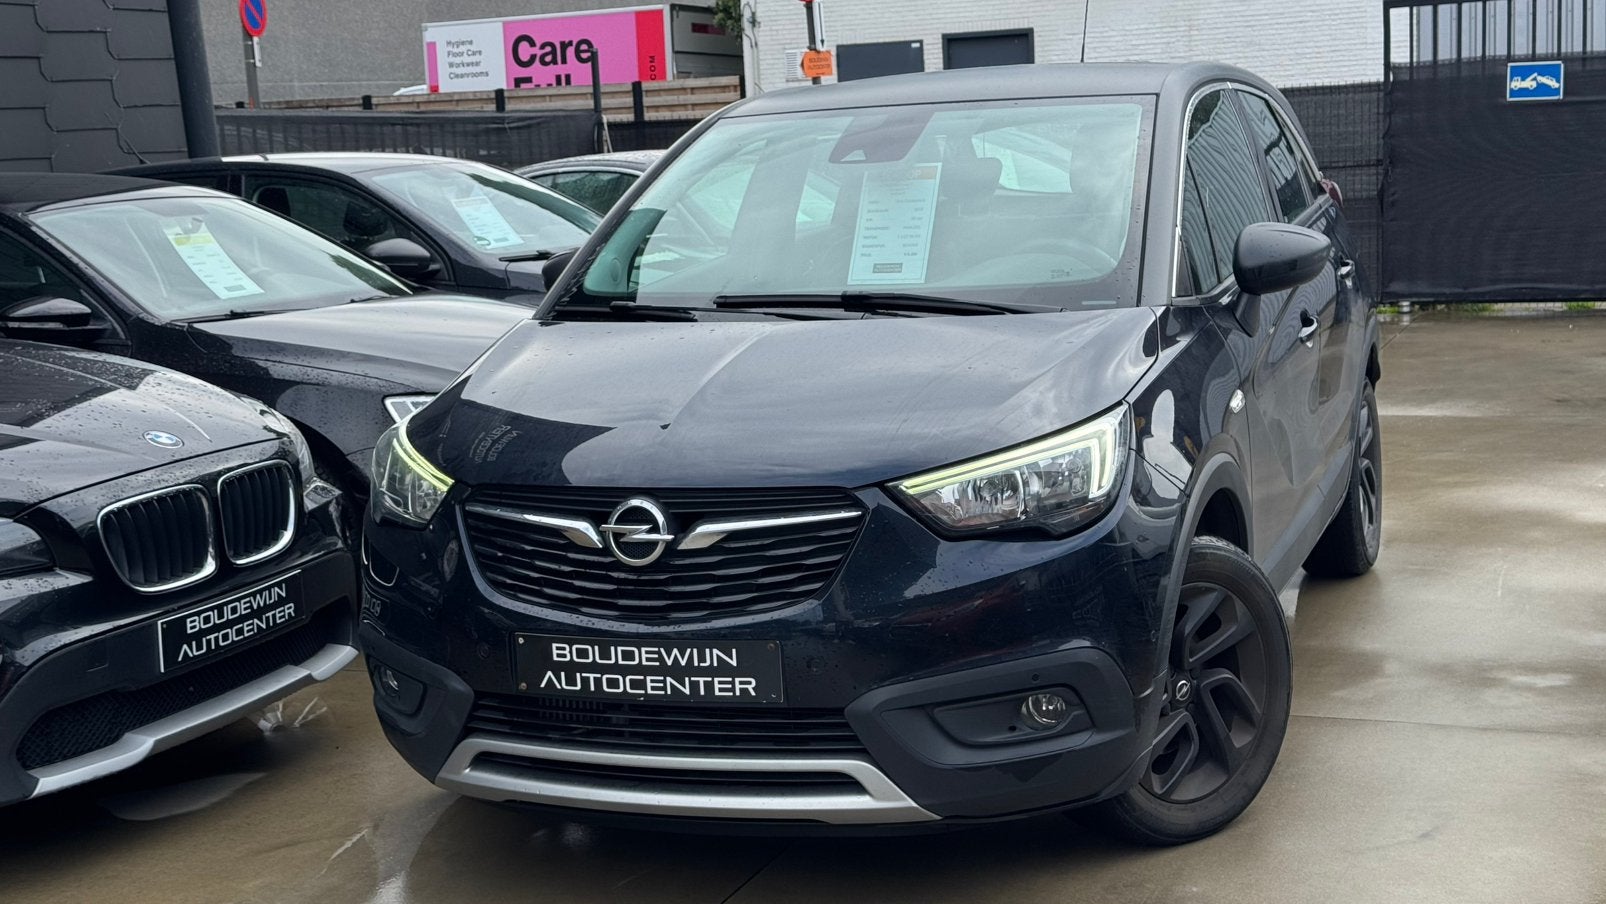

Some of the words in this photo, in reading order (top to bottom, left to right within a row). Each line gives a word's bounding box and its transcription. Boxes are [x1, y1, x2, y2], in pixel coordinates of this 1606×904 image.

[446, 38, 473, 49] Hygiene
[447, 50, 465, 58] Floor
[466, 49, 482, 57] Care
[512, 34, 594, 68] Care
[447, 60, 482, 69] Workwear
[448, 70, 489, 80] Cleanrooms
[186, 583, 287, 634] BOUDEWIJN
[177, 602, 295, 662] AUTOCENTER
[551, 642, 738, 667] BOUDEWIJN
[540, 670, 756, 696] AUTOCENTER
